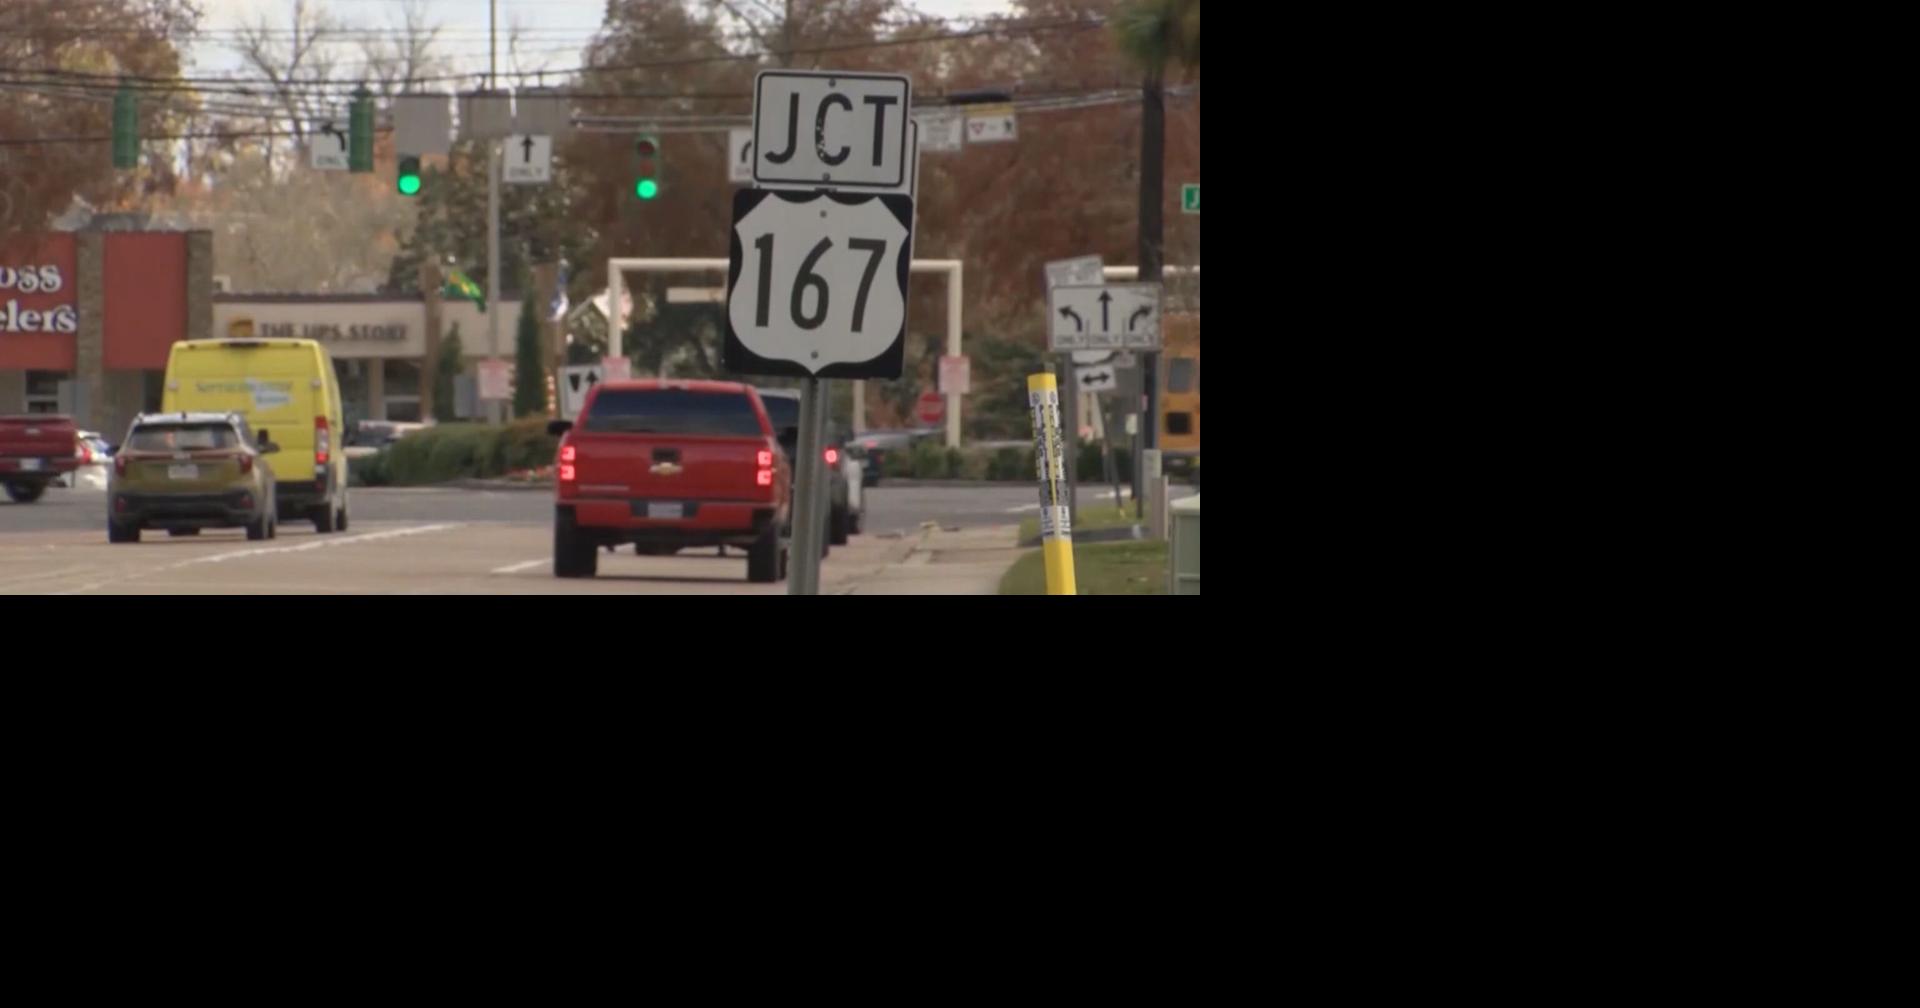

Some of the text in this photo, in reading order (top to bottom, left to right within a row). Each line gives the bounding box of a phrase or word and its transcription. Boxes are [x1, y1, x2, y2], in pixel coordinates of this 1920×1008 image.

[764, 91, 899, 167] JCT
[754, 232, 888, 333] 167
[260, 322, 409, 341] THE UPS STORE
